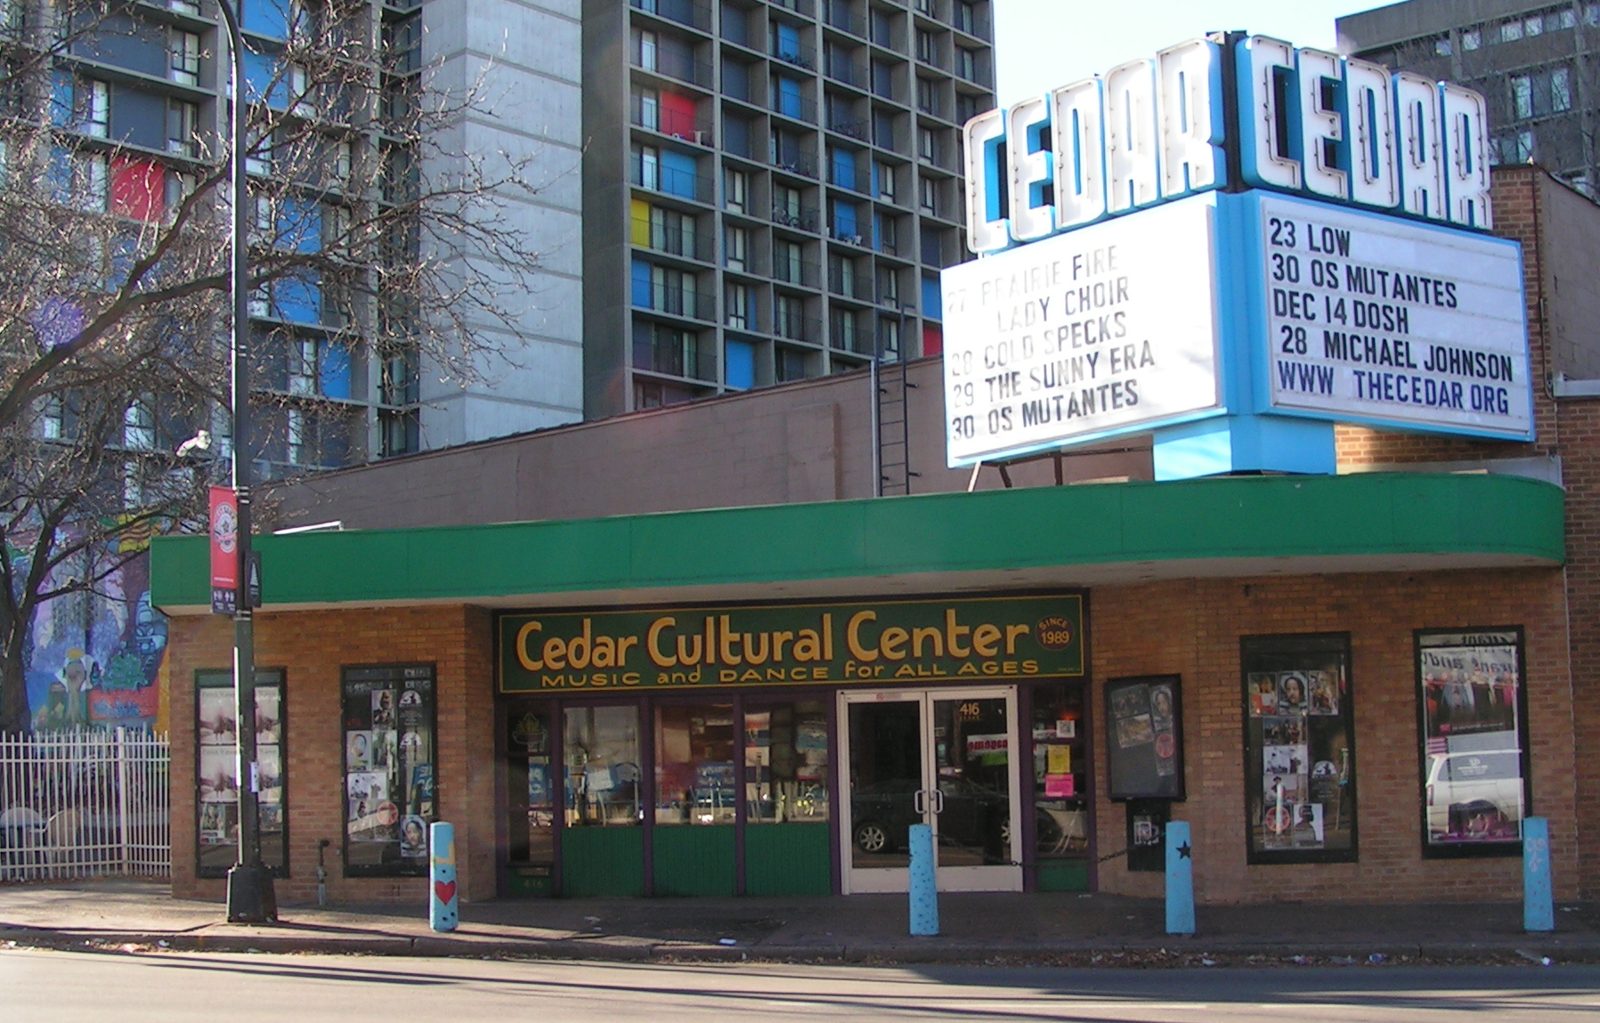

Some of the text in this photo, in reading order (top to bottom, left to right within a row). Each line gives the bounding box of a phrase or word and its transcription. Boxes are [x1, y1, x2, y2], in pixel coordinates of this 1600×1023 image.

[963, 37, 1227, 254] CEDAR
[1234, 35, 1494, 230] CEDAR
[1073, 245, 1119, 281] FIRE
[1269, 218, 1350, 258] 23 LOW
[997, 276, 1129, 333] LADY CHOIR
[1272, 253, 1458, 309] 30 OS MUTANTES
[1273, 288, 1409, 334] DEC 14 DOSH
[984, 335, 1034, 370] COLD
[1043, 311, 1127, 355] SPECKS
[1280, 324, 1513, 382] 28 MICHAEL JOHNSON
[953, 339, 1155, 408] 29 THE SUNNY ERA
[1277, 360, 1334, 396] WWW
[1470, 384, 1510, 415] ORG
[952, 378, 1139, 441] 30 OS MUTANTES
[516, 608, 1031, 672] Cedar Cultural Center
[1039, 617, 1068, 630] SINCE
[1040, 631, 1070, 645] 1989
[541, 660, 1039, 687] MUSIC and DANCE for ALL AGES
[959, 702, 980, 716] 416
